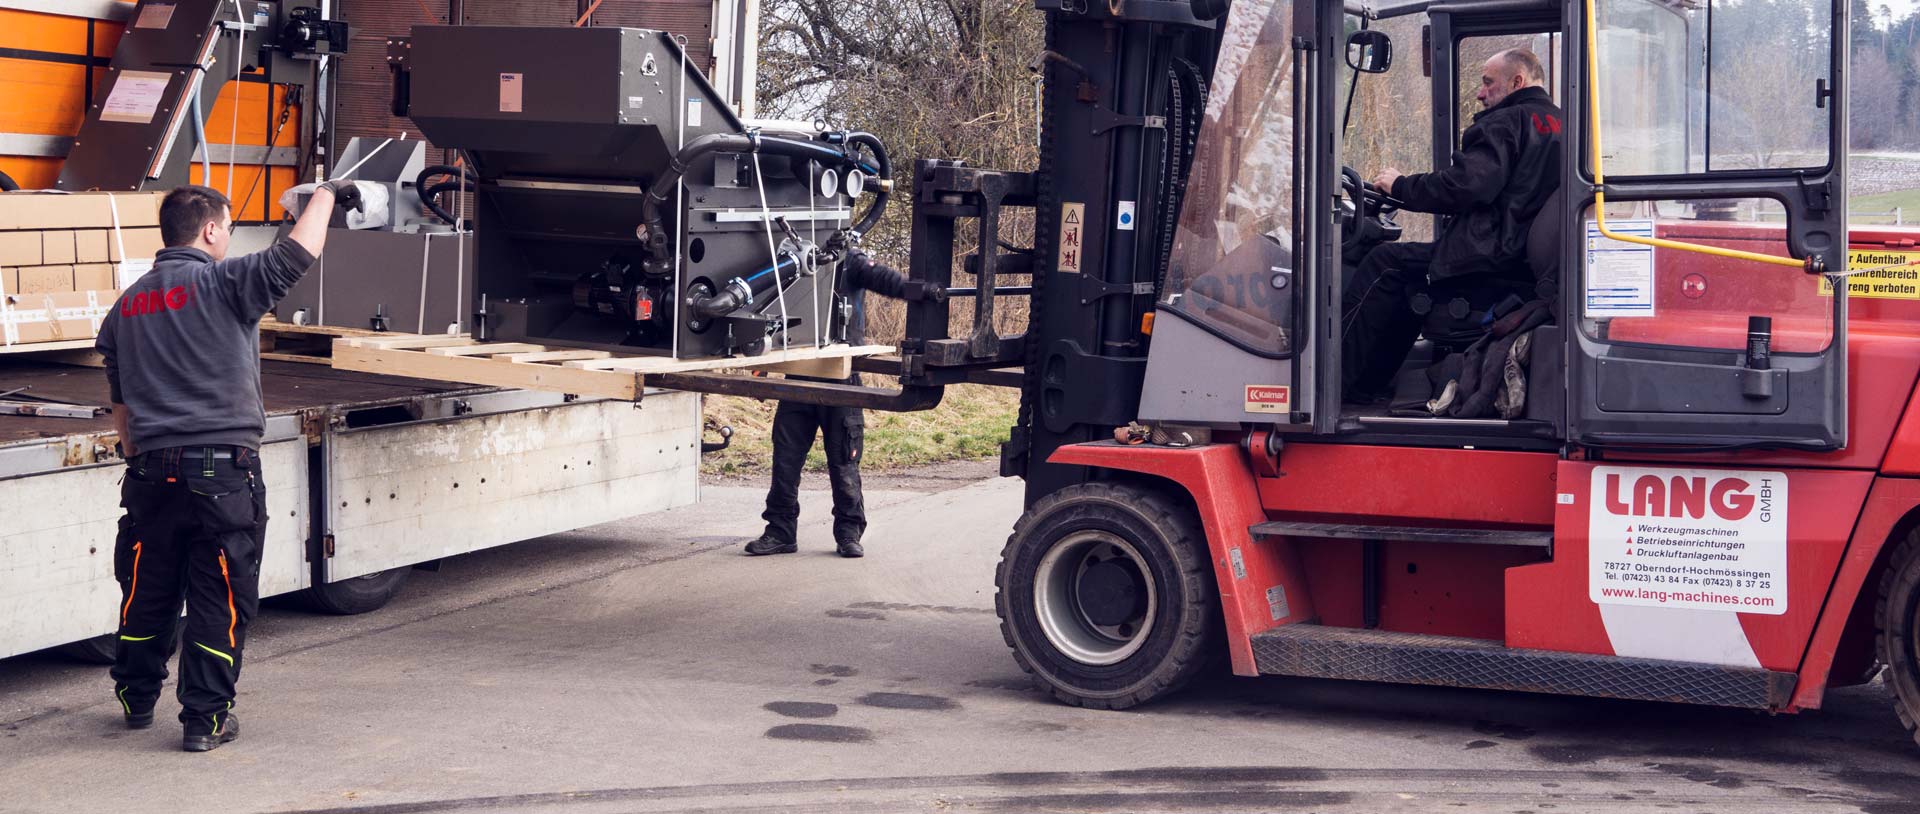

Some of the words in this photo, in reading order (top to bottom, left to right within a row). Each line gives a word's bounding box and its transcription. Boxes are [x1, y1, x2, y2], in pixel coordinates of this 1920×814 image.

[1856, 254, 1906, 264] Aufenthalt
[1873, 283, 1915, 294] verboten
[121, 285, 188, 318] LANG
[1606, 473, 1755, 521] LANG
[1760, 479, 1772, 522] GMBH
[1638, 524, 1739, 537] Werkzeugmaschinen
[1637, 536, 1745, 550] Betriebseinrichtungen
[1637, 548, 1739, 561] Druckluftanlagenbau
[1604, 562, 1631, 570] 78727
[1635, 563, 1771, 579] Oberndorf-Hochmössingen
[1605, 572, 1618, 580] Tel.
[1622, 573, 1651, 582] (07423)
[1654, 575, 1665, 583] 43
[1683, 577, 1699, 585] Fax
[1702, 578, 1733, 588] (07423)
[1745, 580, 1756, 588] 37
[1760, 581, 1771, 589] 25
[1602, 587, 1774, 607] www.lang-machines.com
